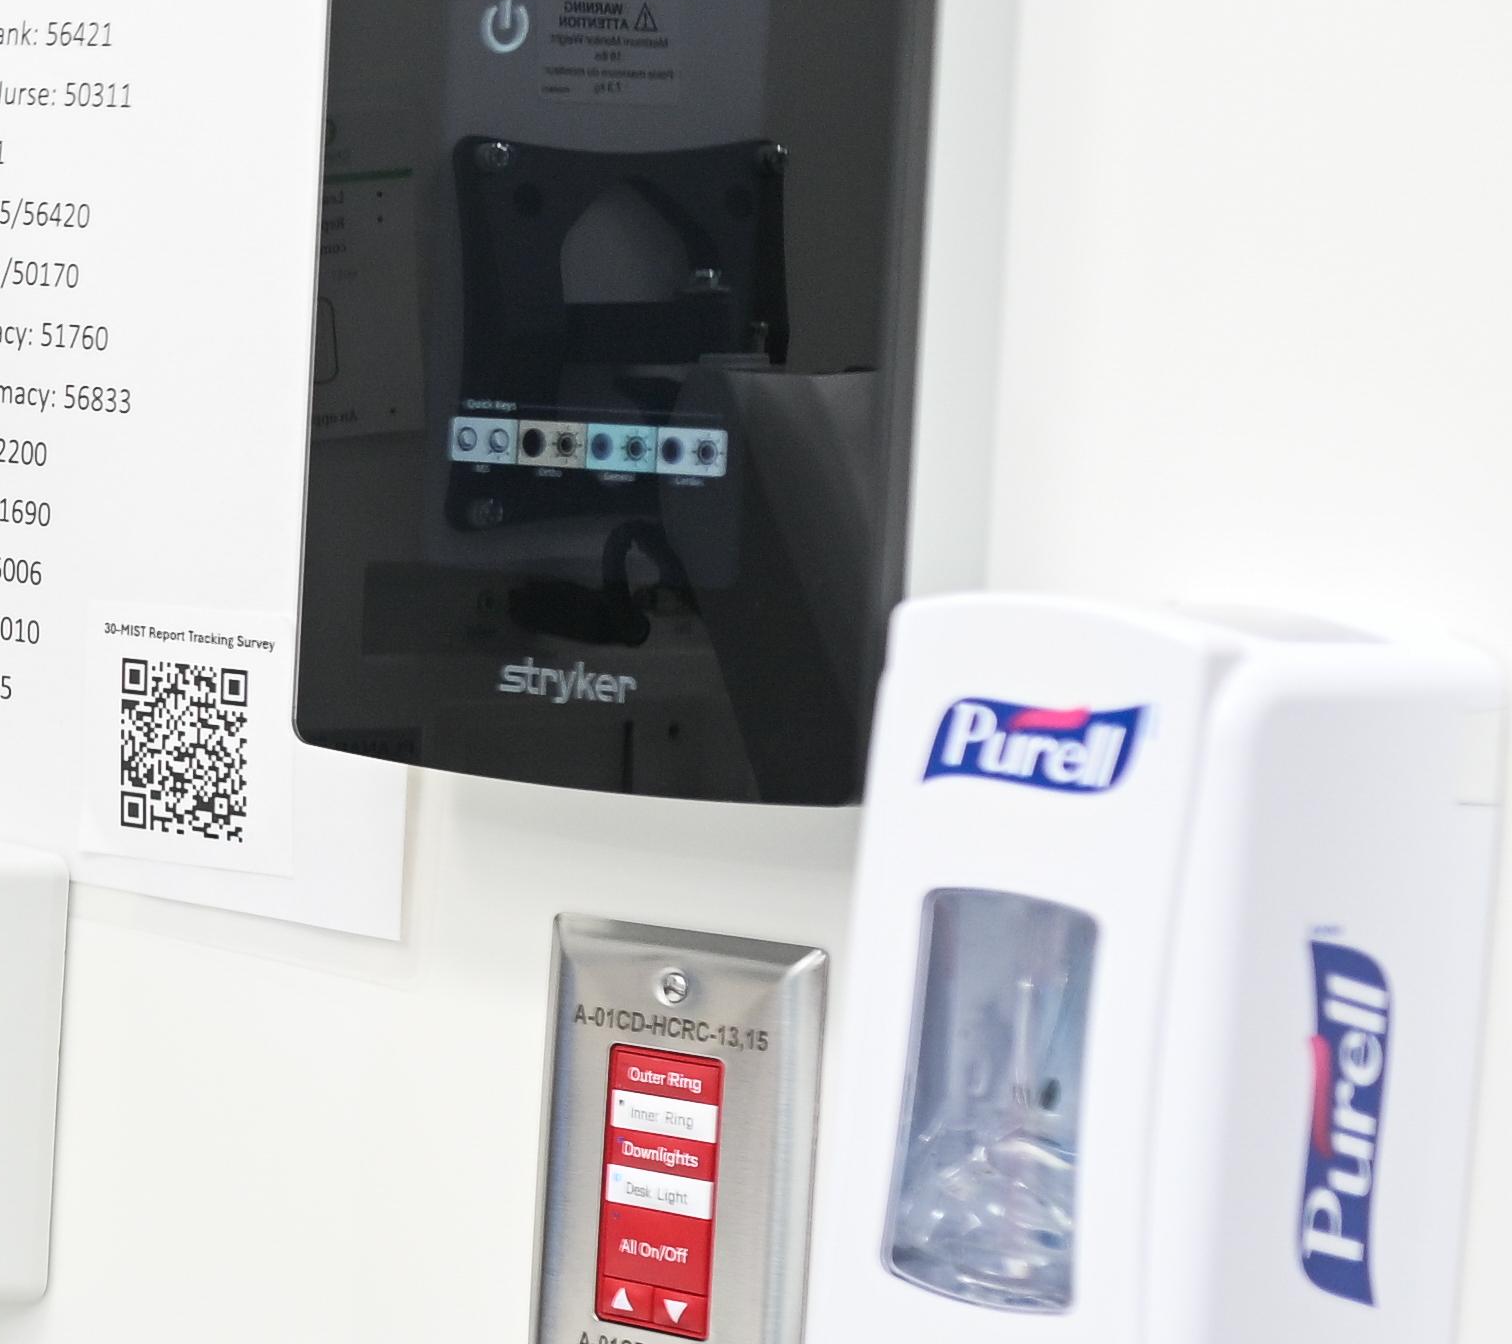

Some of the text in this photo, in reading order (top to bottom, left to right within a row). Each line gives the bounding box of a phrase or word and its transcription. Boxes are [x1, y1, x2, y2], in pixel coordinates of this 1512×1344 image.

[45, 20, 112, 48] 56421
[63, 81, 132, 109] 50311
[40, 321, 109, 352] 51760
[63, 383, 131, 415] 56833
[103, 621, 276, 654] 30-MIST Report Tracking Survey
[499, 656, 638, 705] stryker
[941, 702, 1127, 792] Purell
[571, 1003, 769, 1052] A-01CD-HCRC-13,15
[626, 1066, 703, 1095] Outer Ring
[630, 1106, 695, 1132] Inner Ring
[1302, 972, 1389, 1262] Purell
[621, 1140, 699, 1169] Downlights
[656, 1188, 689, 1207] Light
[618, 1237, 689, 1265] All On/Off
